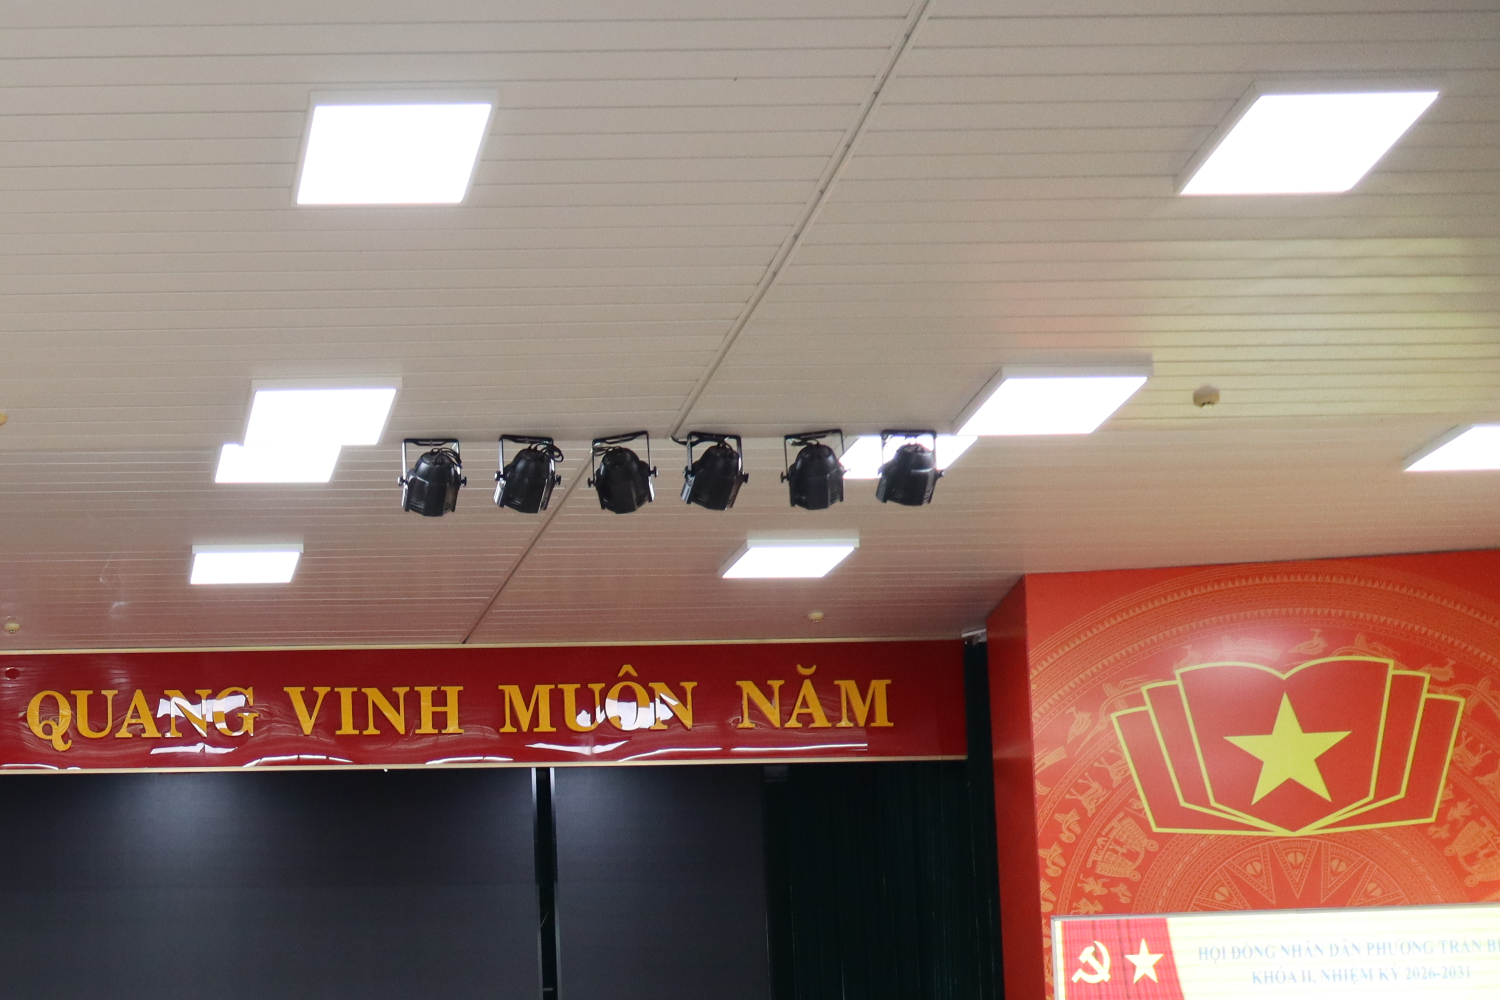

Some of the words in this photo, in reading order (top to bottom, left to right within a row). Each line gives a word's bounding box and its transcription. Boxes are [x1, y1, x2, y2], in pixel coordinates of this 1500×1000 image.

[26, 686, 259, 752] QUANG
[283, 685, 465, 736] VINH
[498, 664, 698, 733] MUÔN
[735, 664, 894, 730] NĂM
[1405, 965, 1471, 980] 2026-2031
